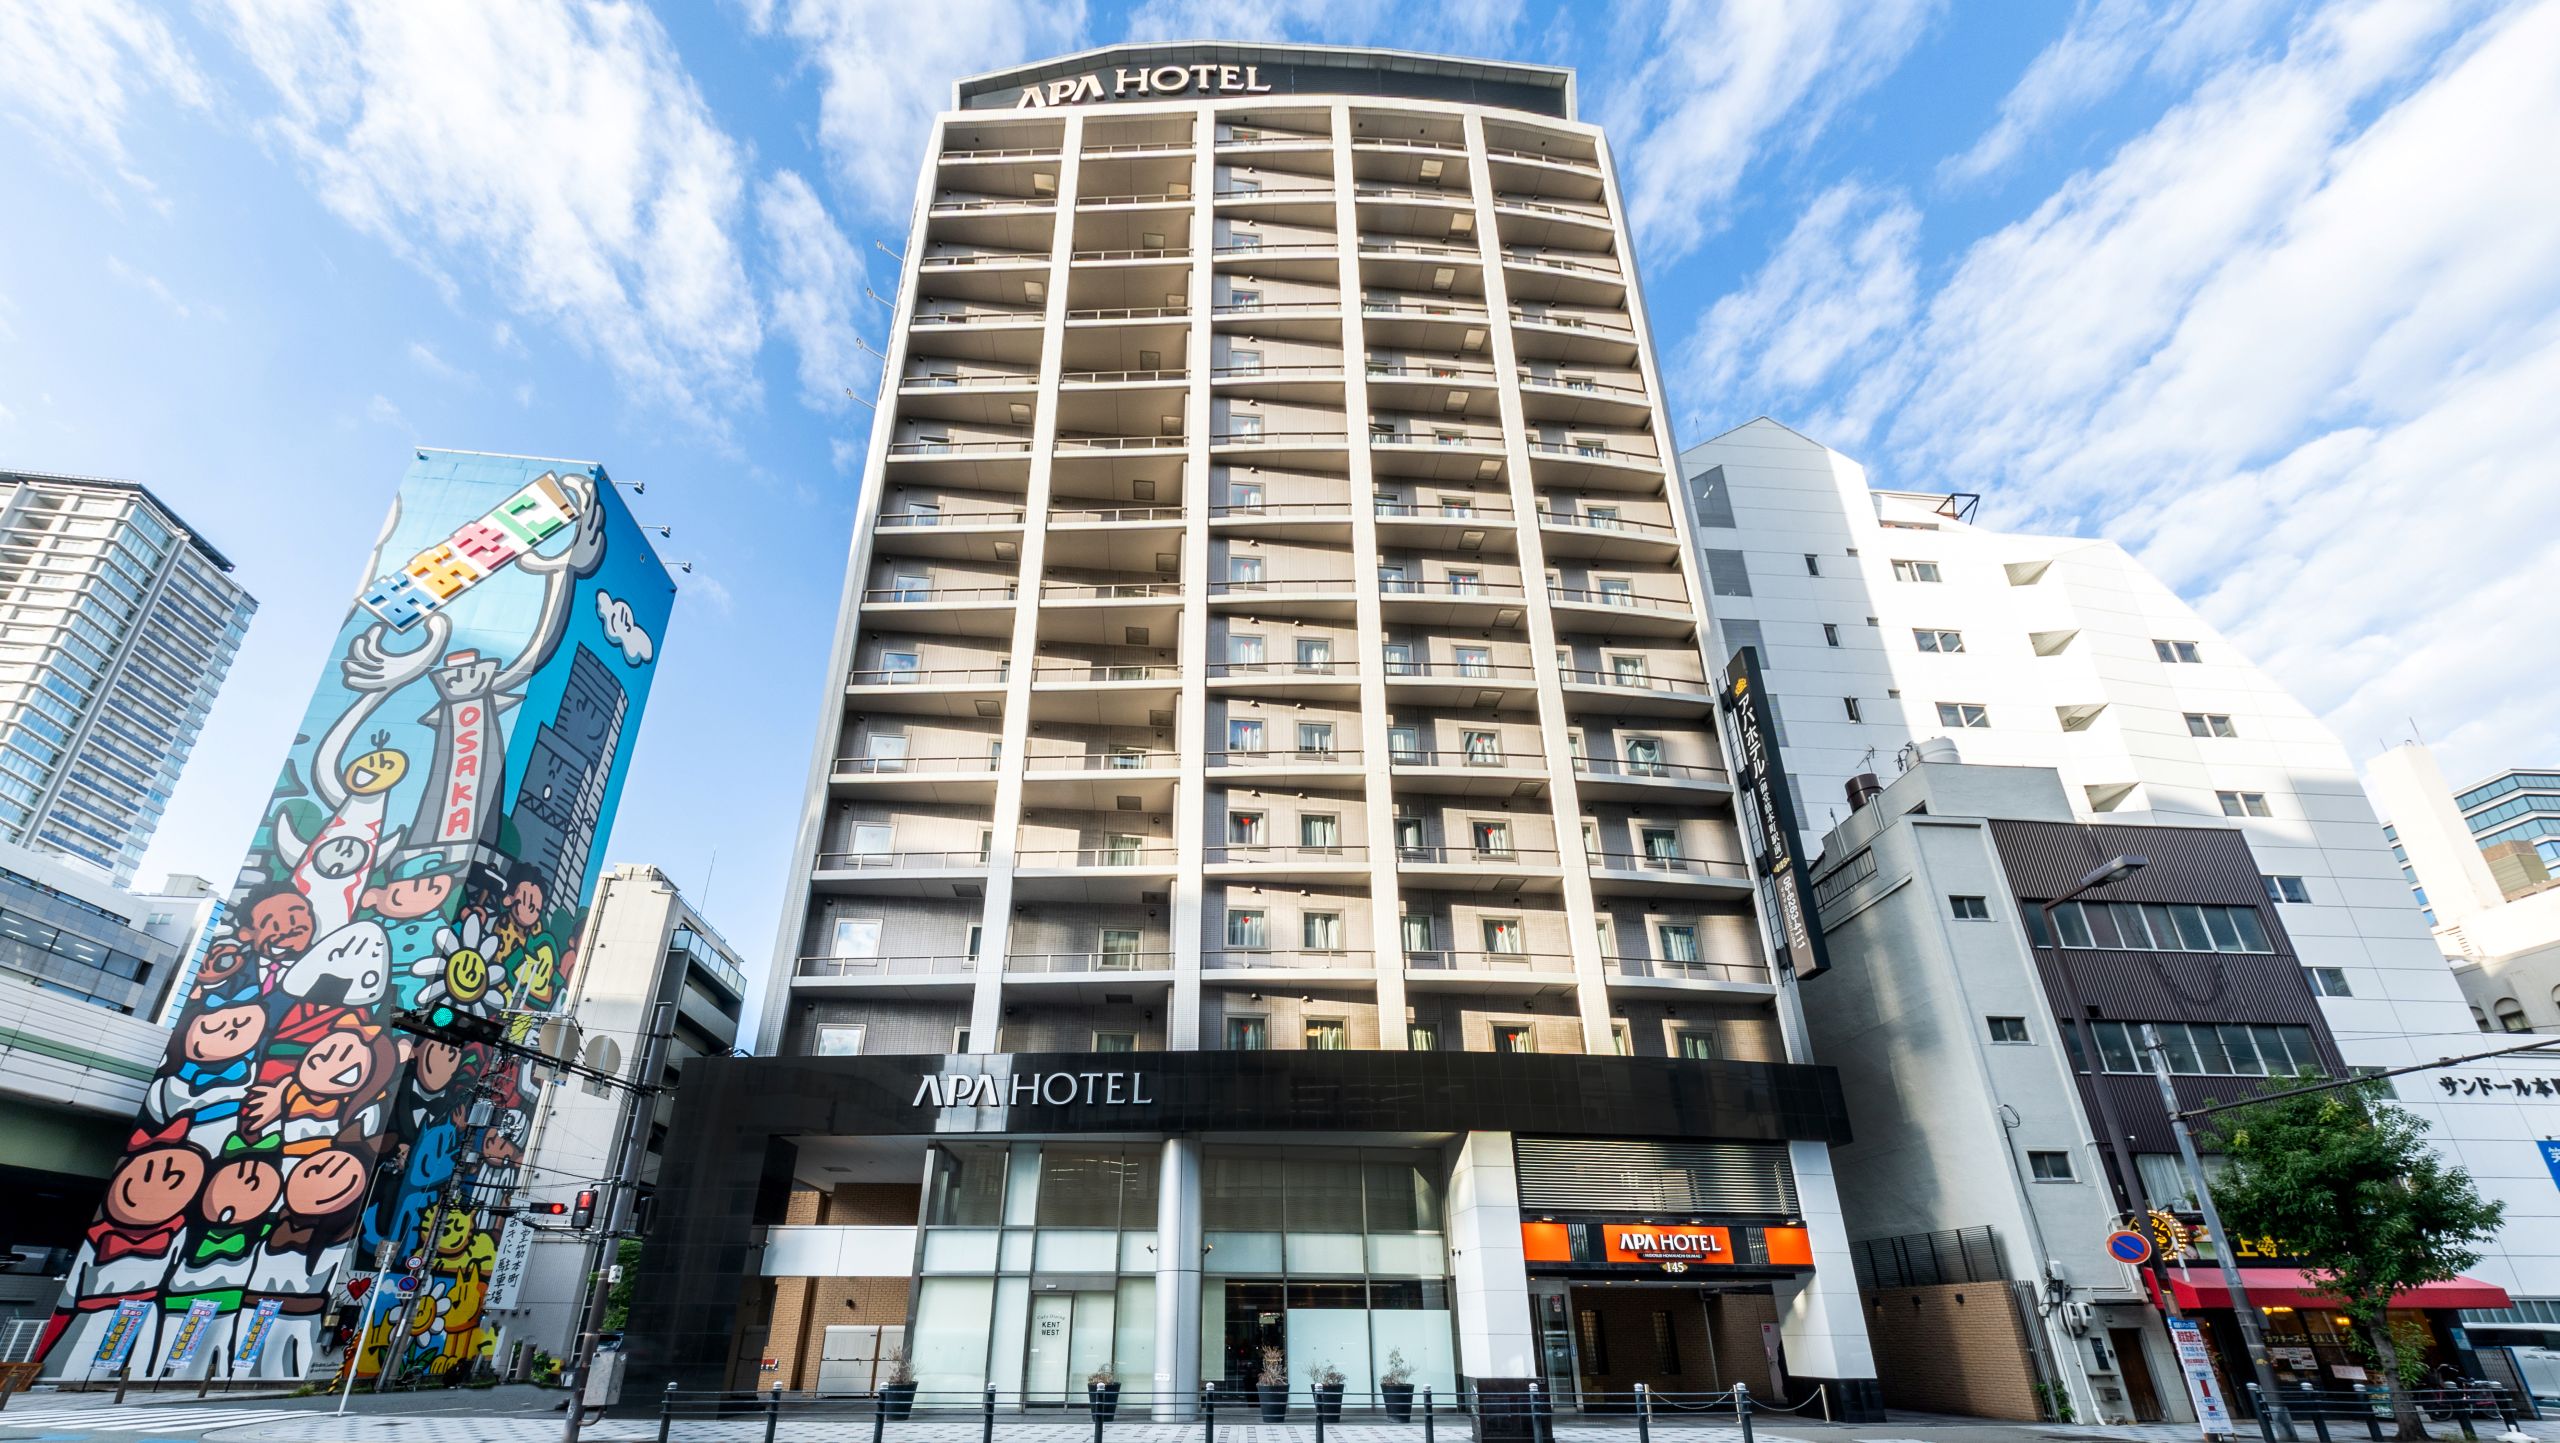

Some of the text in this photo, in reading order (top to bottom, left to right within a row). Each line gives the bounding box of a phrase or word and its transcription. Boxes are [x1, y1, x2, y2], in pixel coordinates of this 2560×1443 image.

[1016, 64, 1271, 109] APA HOTEL
[445, 706, 481, 836] OSAKA
[1782, 876, 1806, 949] 06-6263-4111
[912, 1072, 1152, 1106] APA HOTEL
[1620, 1233, 1721, 1251] APA HOTEL
[1666, 1262, 1684, 1273] 145
